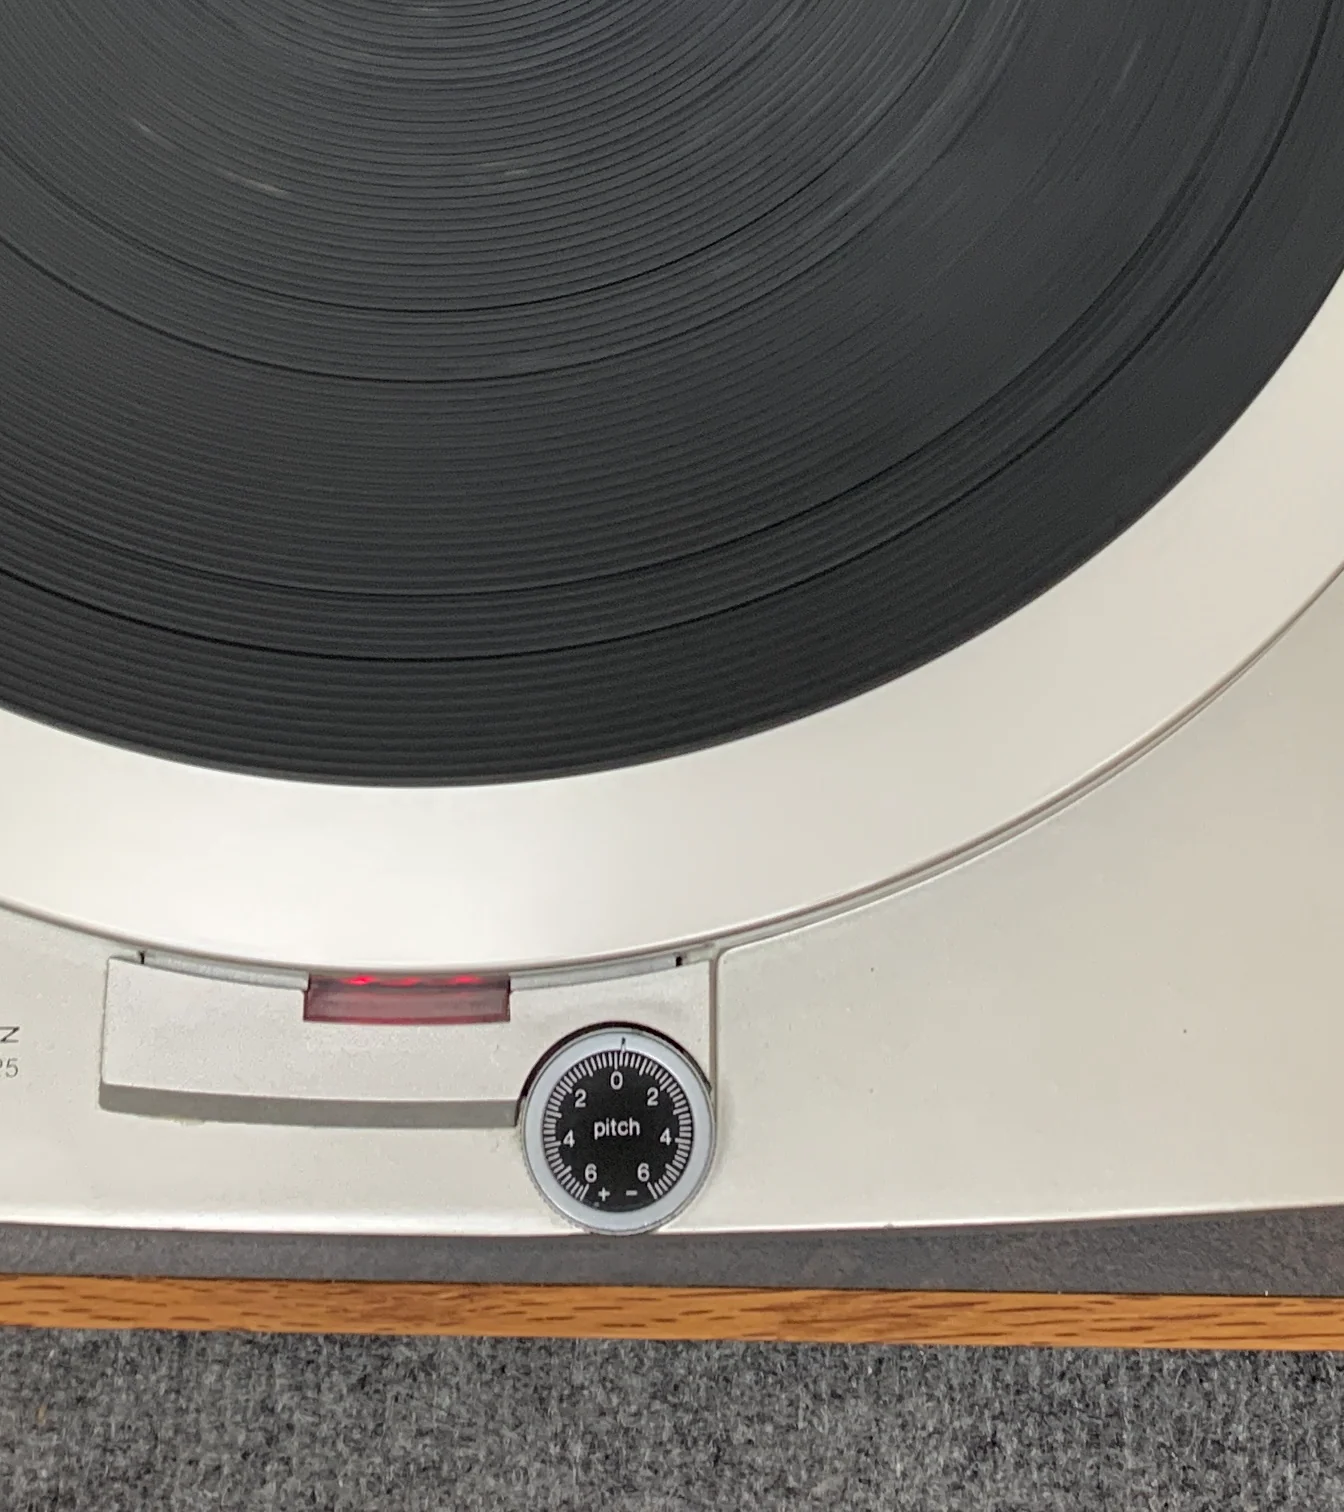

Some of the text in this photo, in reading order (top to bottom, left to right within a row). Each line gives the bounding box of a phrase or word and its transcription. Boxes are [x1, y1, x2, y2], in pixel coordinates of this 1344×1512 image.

[610, 1071, 623, 1090] 0
[574, 1089, 587, 1108] 2
[647, 1087, 659, 1107] 2
[593, 1117, 641, 1140] pitch
[659, 1128, 672, 1146] 4
[563, 1129, 575, 1148] 4
[584, 1163, 598, 1183] 6
[637, 1162, 650, 1182] 6
